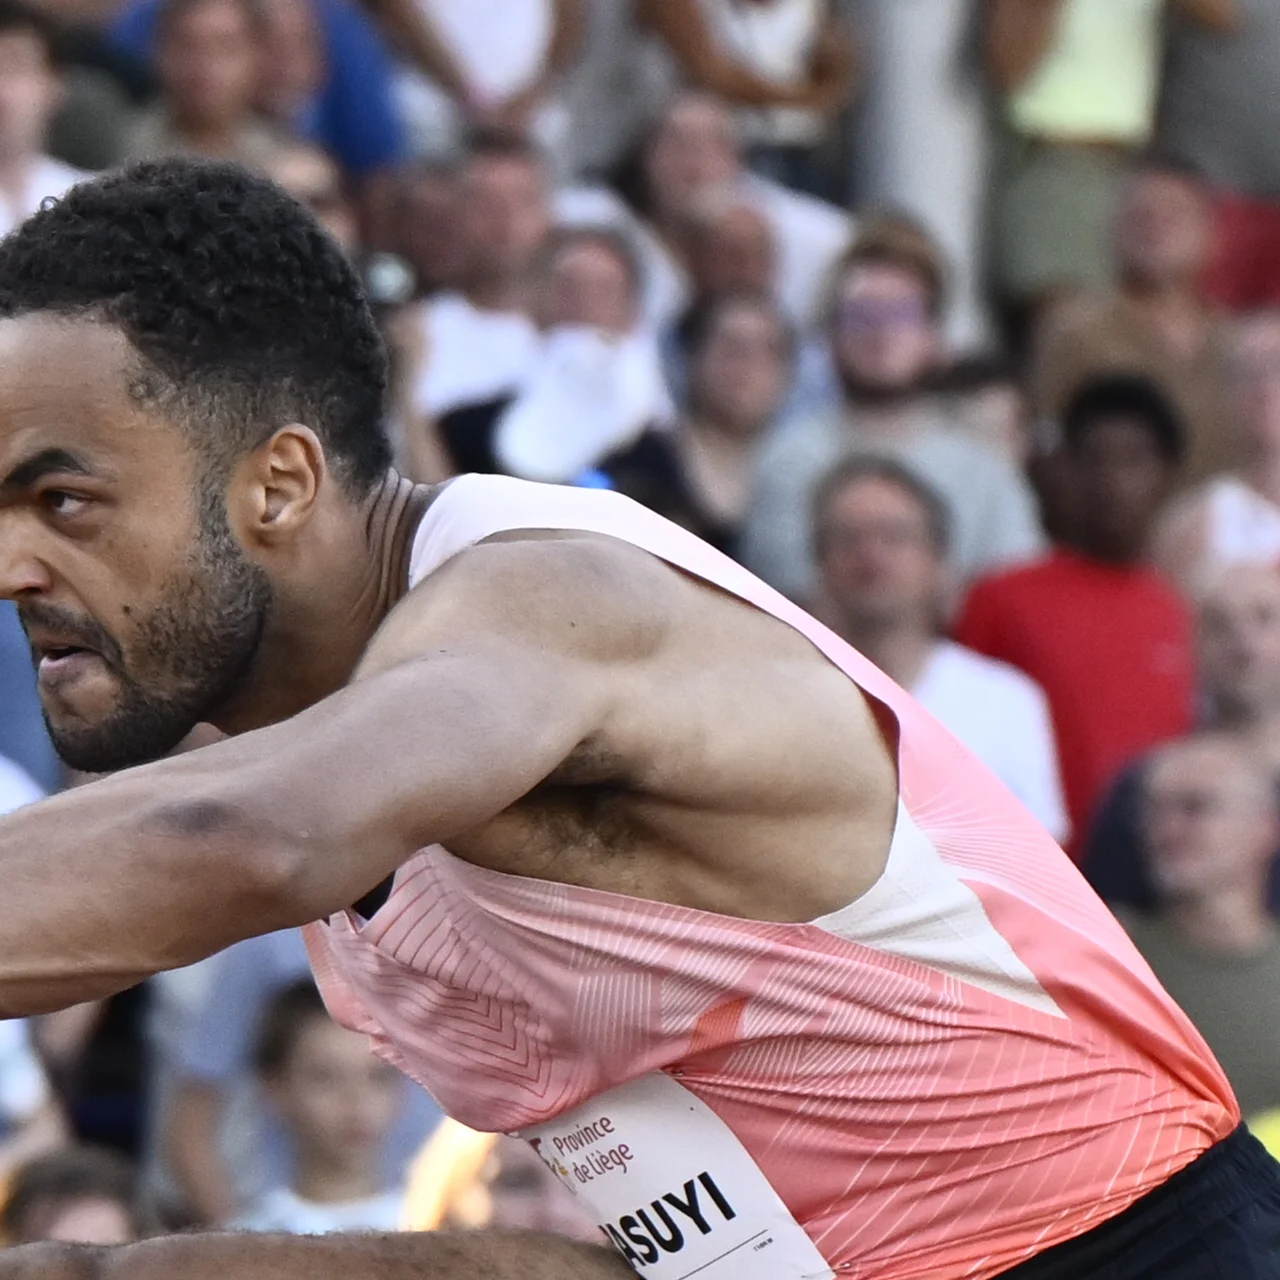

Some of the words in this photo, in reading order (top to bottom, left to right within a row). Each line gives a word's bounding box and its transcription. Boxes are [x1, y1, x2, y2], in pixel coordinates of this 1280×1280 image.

[552, 1115, 615, 1157] Province
[572, 1161, 594, 1184] de
[599, 1171, 737, 1270] ASUYI
